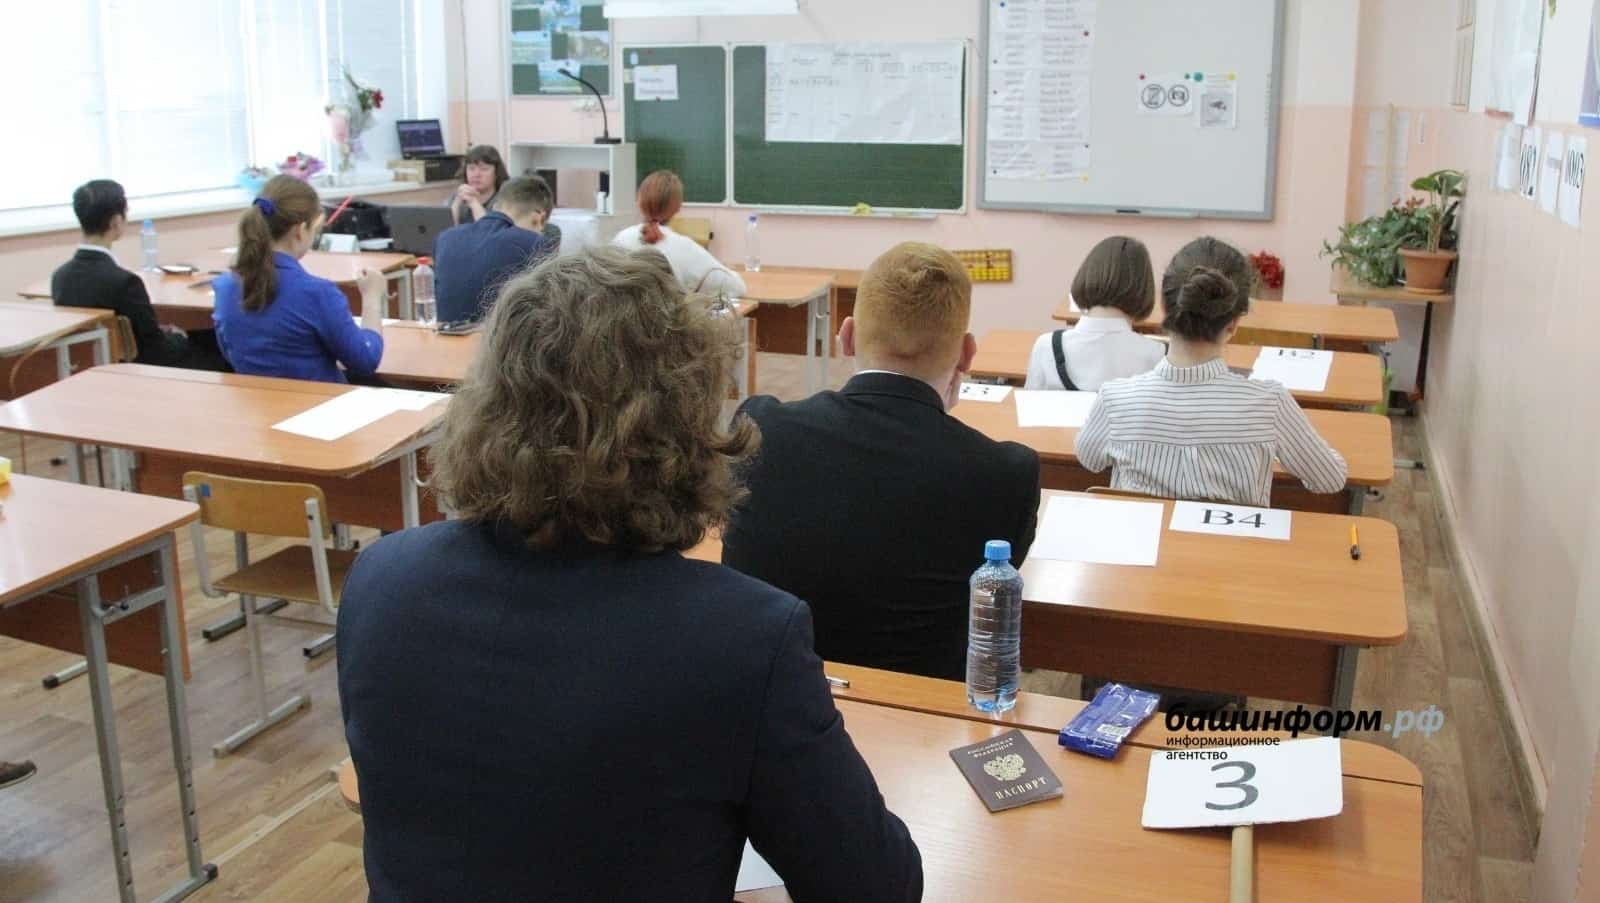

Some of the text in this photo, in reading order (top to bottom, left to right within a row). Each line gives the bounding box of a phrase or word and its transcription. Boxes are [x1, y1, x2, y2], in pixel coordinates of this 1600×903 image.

[1200, 508, 1267, 529] В4
[994, 776, 1048, 800] ПАСПОРТ
[1204, 760, 1260, 811] 3
